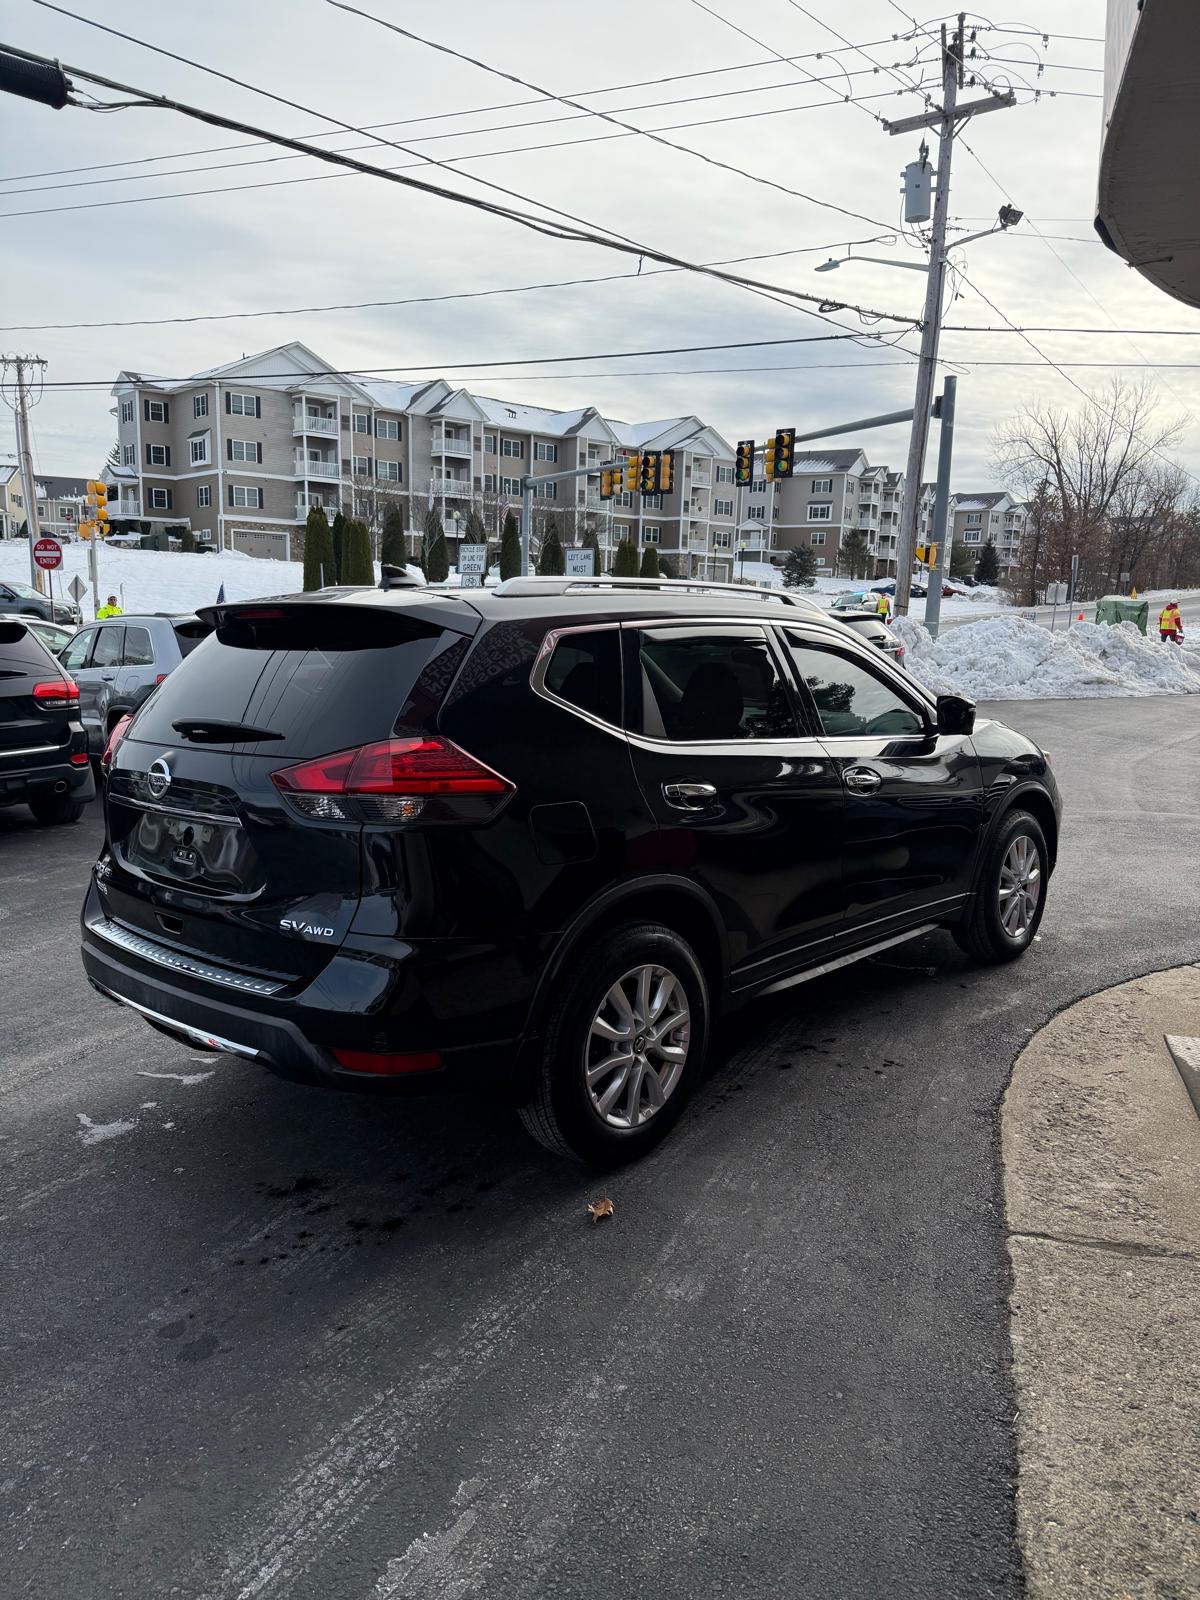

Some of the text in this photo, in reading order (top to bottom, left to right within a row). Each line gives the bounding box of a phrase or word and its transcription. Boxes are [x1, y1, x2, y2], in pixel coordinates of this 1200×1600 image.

[40, 557, 57, 565] ENTER
[568, 553, 592, 561] LEFT LANE
[462, 563, 482, 572] GREEN
[572, 565, 587, 573] MUST
[280, 919, 334, 937] SV AWD
